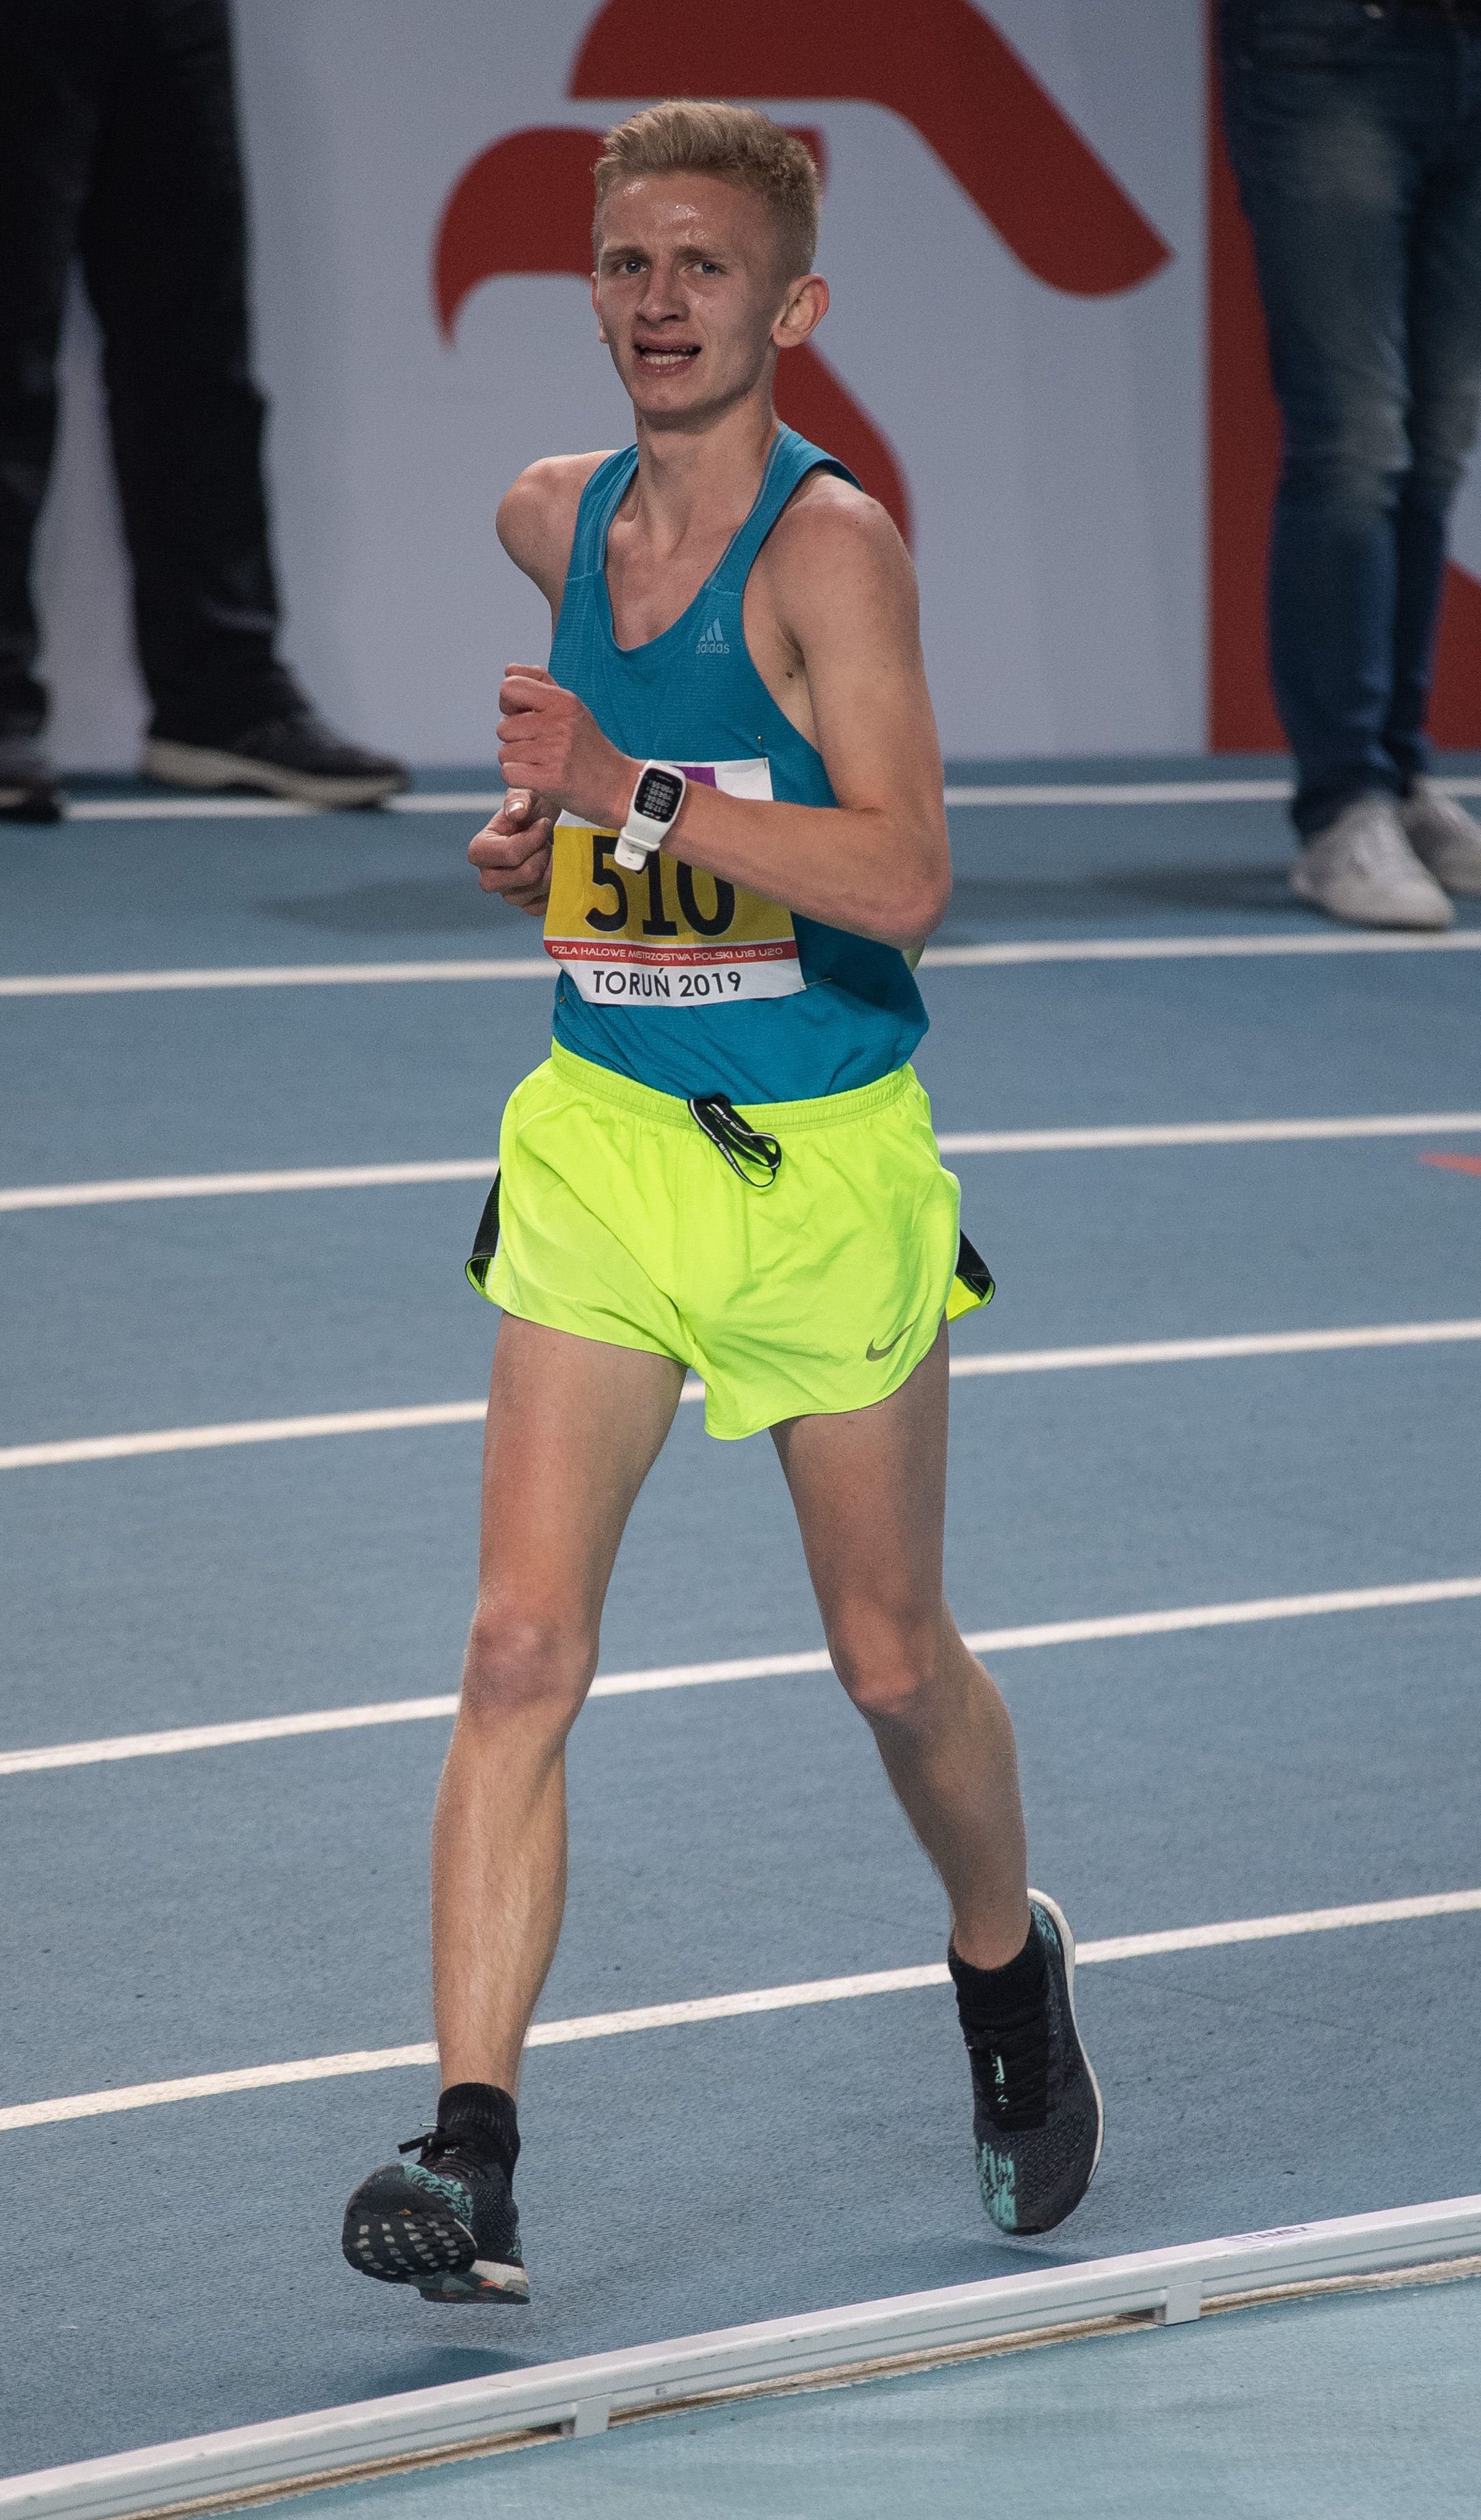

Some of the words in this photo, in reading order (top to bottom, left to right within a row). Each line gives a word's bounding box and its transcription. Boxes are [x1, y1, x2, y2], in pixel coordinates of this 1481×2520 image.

[695, 641, 730, 654] adidas
[585, 835, 736, 937] 510
[552, 945, 579, 955] PZLA
[581, 947, 626, 957] HALOWE
[627, 949, 691, 962] MISTRZOSTWA
[693, 950, 733, 961] POLSKI
[736, 949, 756, 958] U18
[759, 947, 783, 957] U20
[593, 968, 672, 997] TORUŃ
[678, 970, 742, 998] 2019
